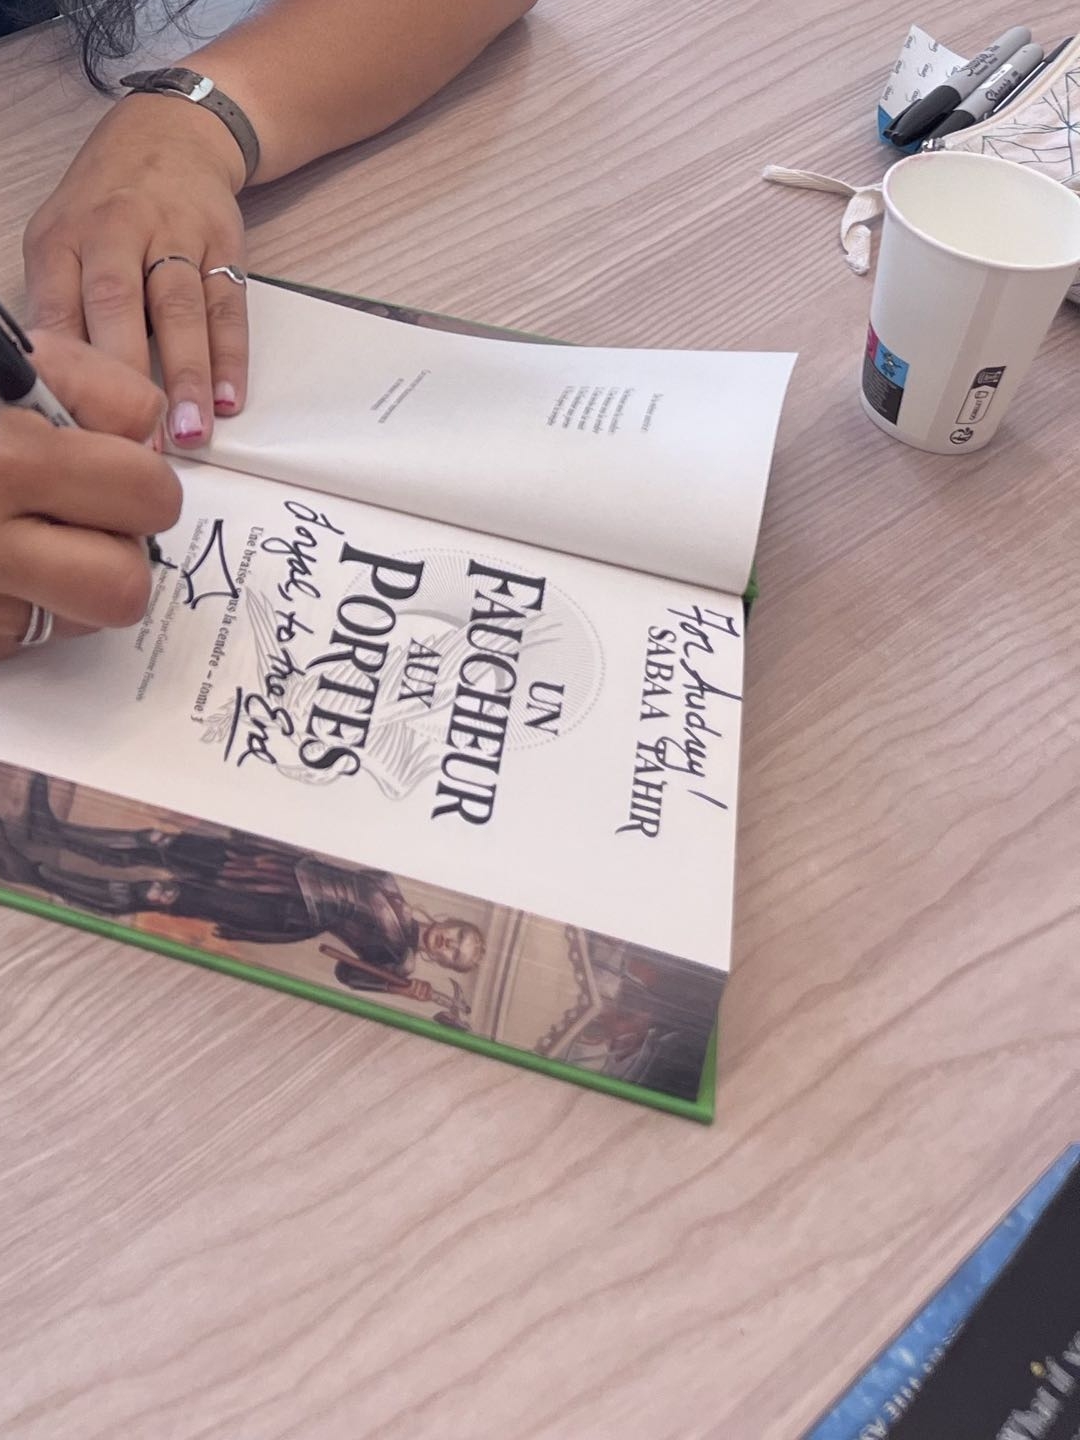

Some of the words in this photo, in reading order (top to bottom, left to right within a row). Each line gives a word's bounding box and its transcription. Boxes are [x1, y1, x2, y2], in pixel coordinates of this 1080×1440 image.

[250, 525, 264, 547] Une
[235, 548, 258, 585] braise
[222, 614, 238, 626] la
[276, 610, 314, 642] to
[667, 605, 740, 658] For
[210, 626, 231, 668] cendre
[299, 542, 424, 776] PORTES
[398, 638, 442, 708] AUX
[640, 625, 677, 721] SABAA
[193, 681, 214, 712] tome
[431, 560, 546, 825] FAUCHEUR
[524, 681, 565, 736] UN
[615, 740, 667, 838] TAHIR
